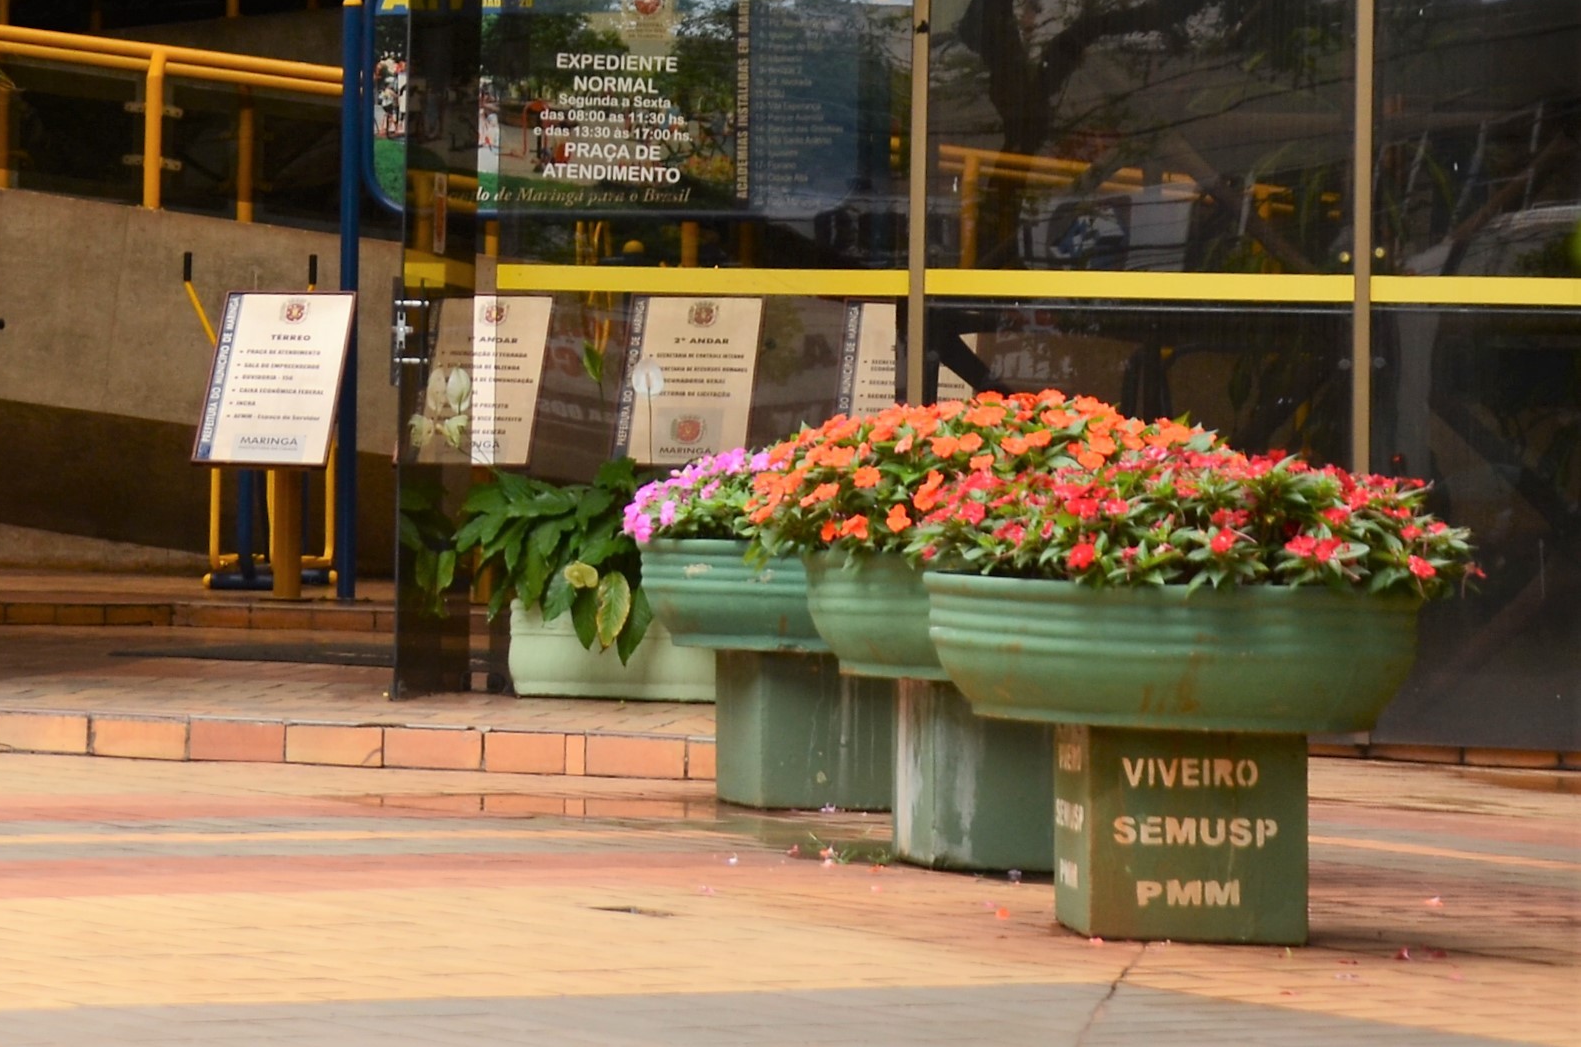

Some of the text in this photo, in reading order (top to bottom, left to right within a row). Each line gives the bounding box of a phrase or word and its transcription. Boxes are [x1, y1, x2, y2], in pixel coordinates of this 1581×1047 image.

[556, 53, 678, 72] EXPEDIENTE
[574, 75, 659, 94] NORMAL
[737, 58, 749, 126] INSTALADAS
[559, 94, 671, 108] Segunda a Sexta
[540, 109, 565, 121] das
[568, 110, 606, 122] 08:00
[626, 112, 665, 124] 11:30
[668, 113, 688, 125] hs.
[533, 127, 542, 136] e
[545, 125, 570, 137] das
[574, 126, 610, 138] 13:30
[634, 128, 670, 140] 17:00
[674, 130, 693, 142] hs.
[565, 142, 661, 162] PRAÇA DE
[543, 162, 681, 183] ATENDIMENTO
[736, 131, 749, 198] ACADEMIAS
[516, 187, 583, 206] Maringá
[479, 336, 518, 344] ANDAR
[202, 401, 218, 442] PREFEITURA
[211, 386, 222, 400] DO
[222, 332, 233, 343] DE
[1121, 757, 1259, 787] VIVEIRO
[1113, 815, 1279, 848] SEMUSP
[1136, 879, 1241, 907] PMM
